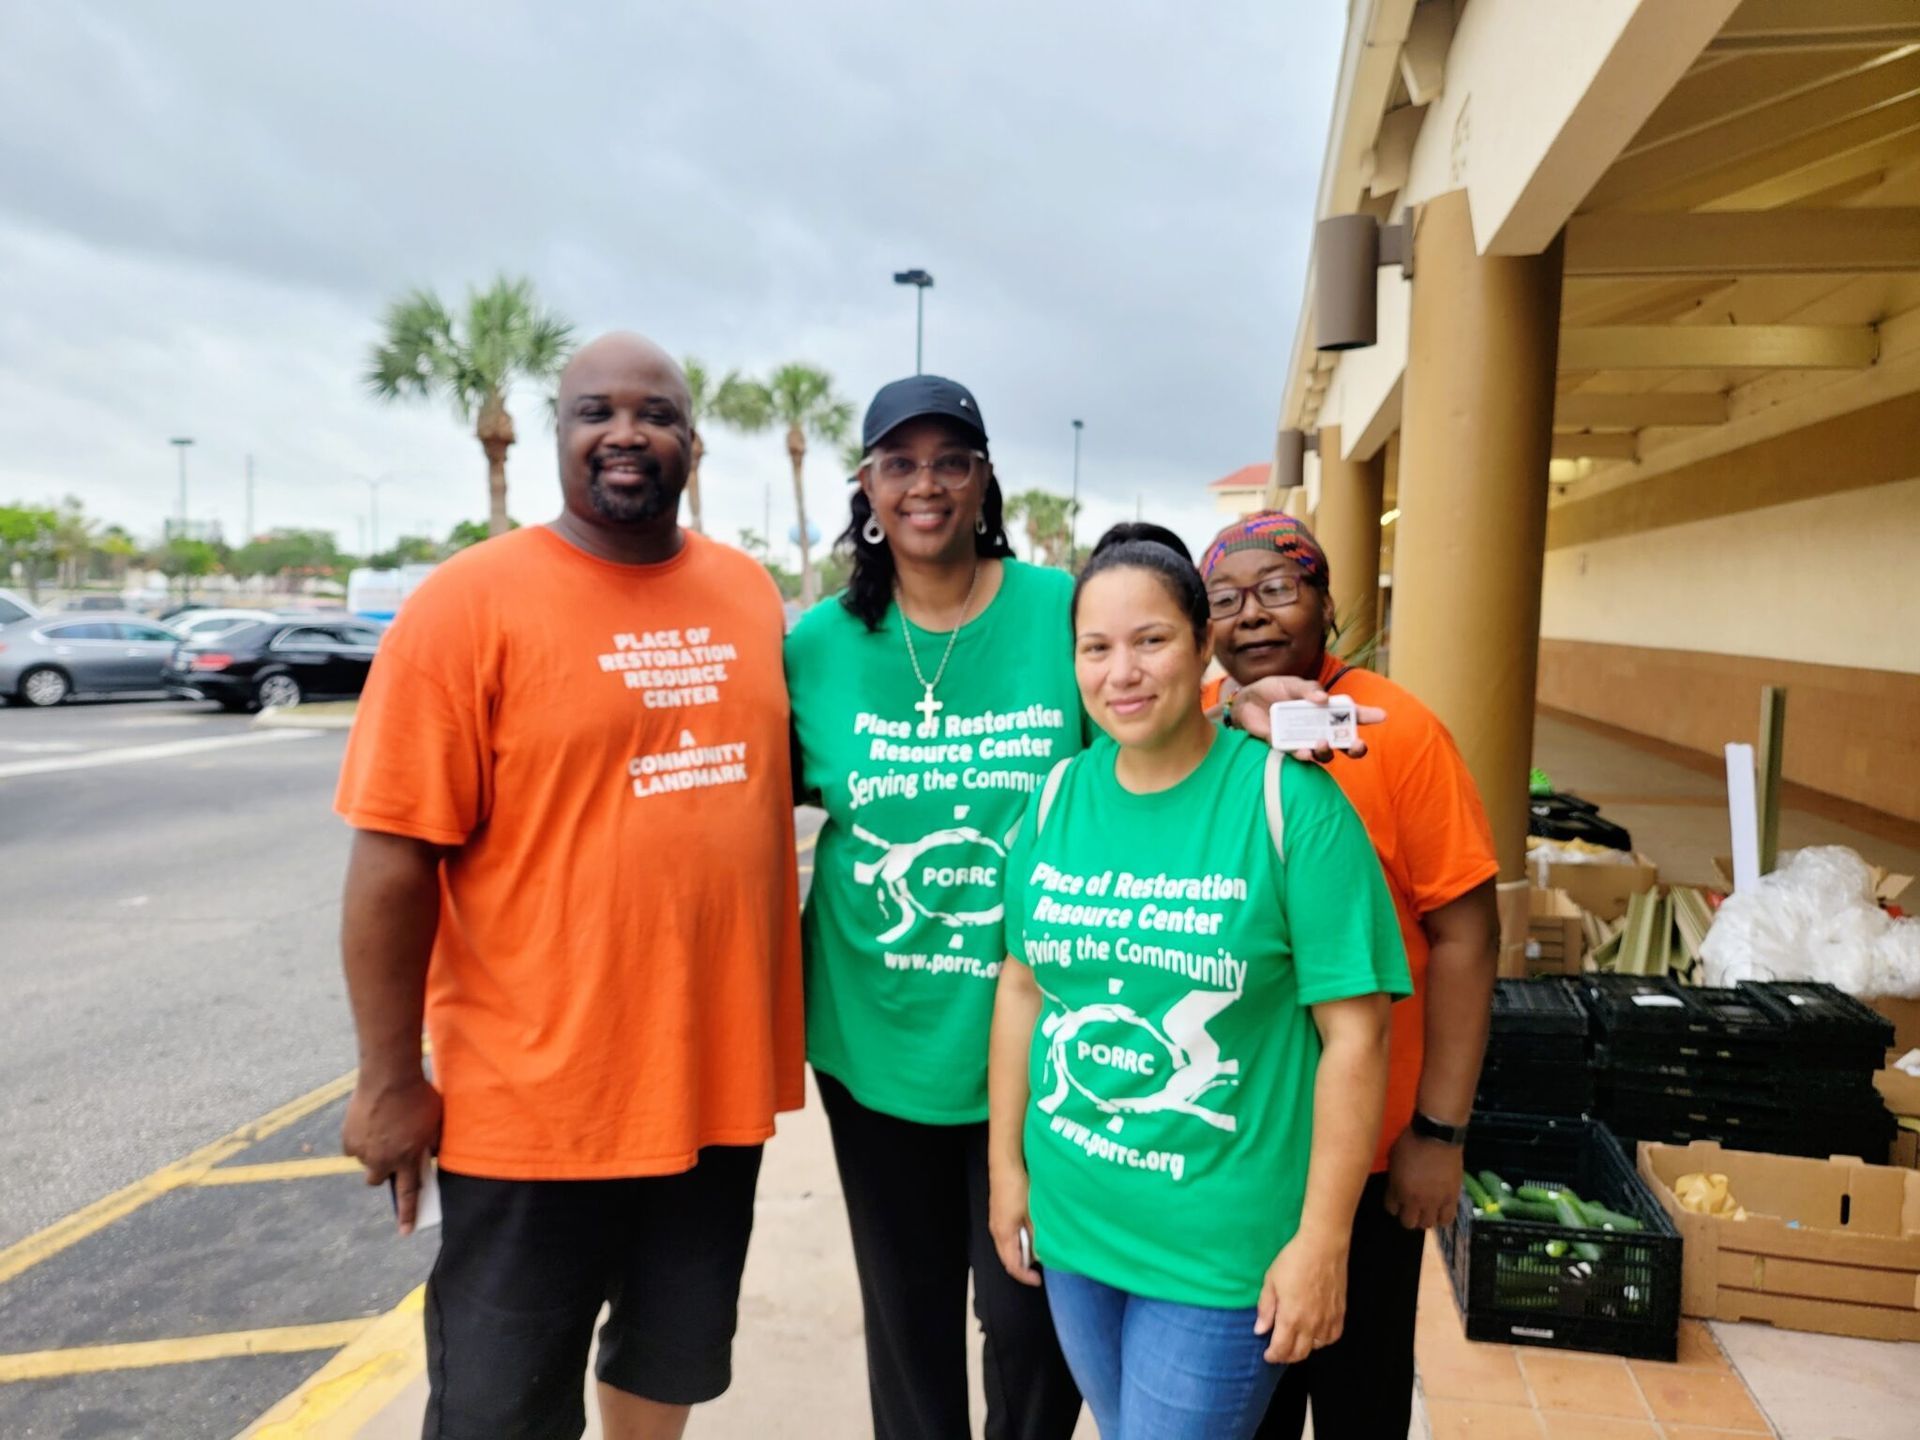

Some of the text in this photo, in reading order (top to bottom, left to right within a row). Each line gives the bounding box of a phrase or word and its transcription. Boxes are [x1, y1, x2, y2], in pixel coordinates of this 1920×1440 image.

[613, 628, 711, 651] PLACE OF
[598, 644, 737, 672] RESTORATION
[623, 664, 727, 689] RESOURCE
[643, 685, 719, 709] CENTER
[854, 712, 911, 739] Place
[945, 704, 1064, 738] Restoration
[679, 729, 696, 748] A
[869, 733, 1053, 763] Resource Center
[629, 742, 747, 776] COMMUNITY
[633, 764, 747, 797] LANDMARK
[848, 767, 1046, 810] Serving the Commu
[923, 866, 998, 888] PORRC
[1029, 862, 1247, 901] Place of Restoration
[1033, 895, 1223, 935] Resource Center
[1076, 933, 1109, 961] the
[1115, 938, 1247, 997] Community
[1077, 1040, 1155, 1075] PORRC
[1050, 1115, 1185, 1181] www.porrc.org
